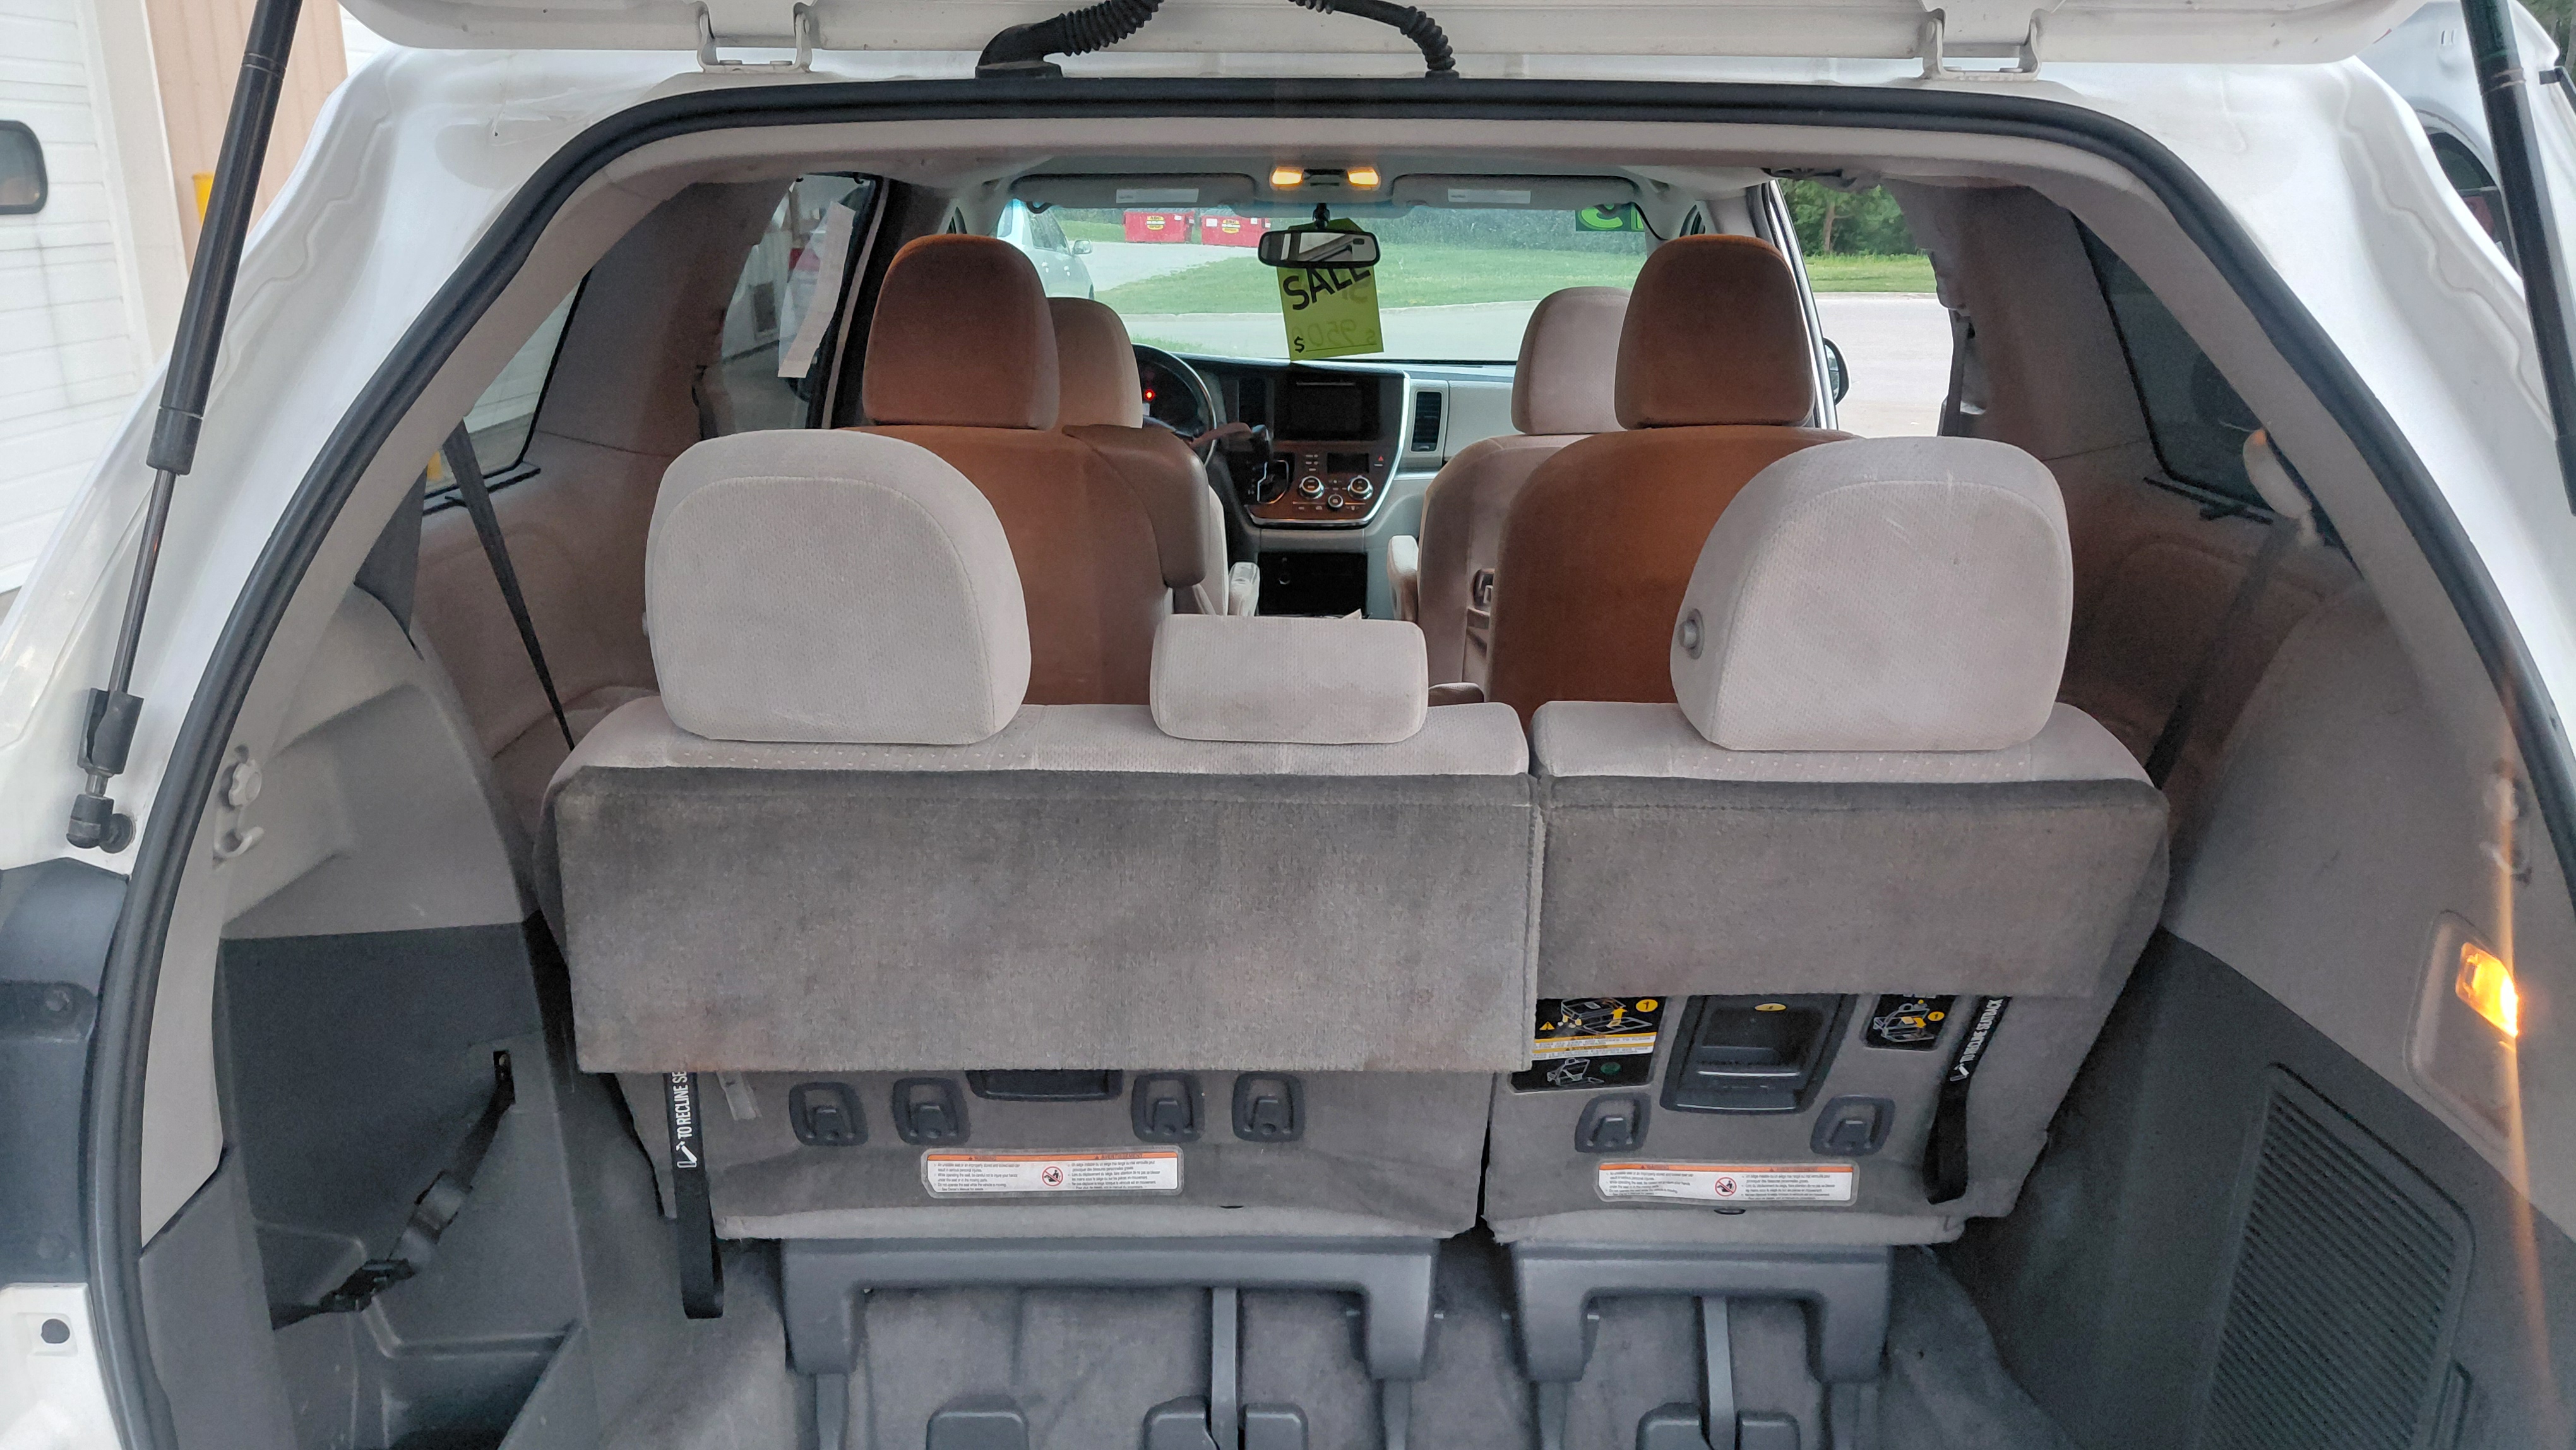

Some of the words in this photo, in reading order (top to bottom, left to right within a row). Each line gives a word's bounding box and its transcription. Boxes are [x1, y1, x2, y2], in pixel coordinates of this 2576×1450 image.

[1294, 336, 1305, 353] $
[1643, 1001, 1649, 1010] 1
[673, 1084, 692, 1125] RECLINE
[677, 1126, 693, 1139] TO
